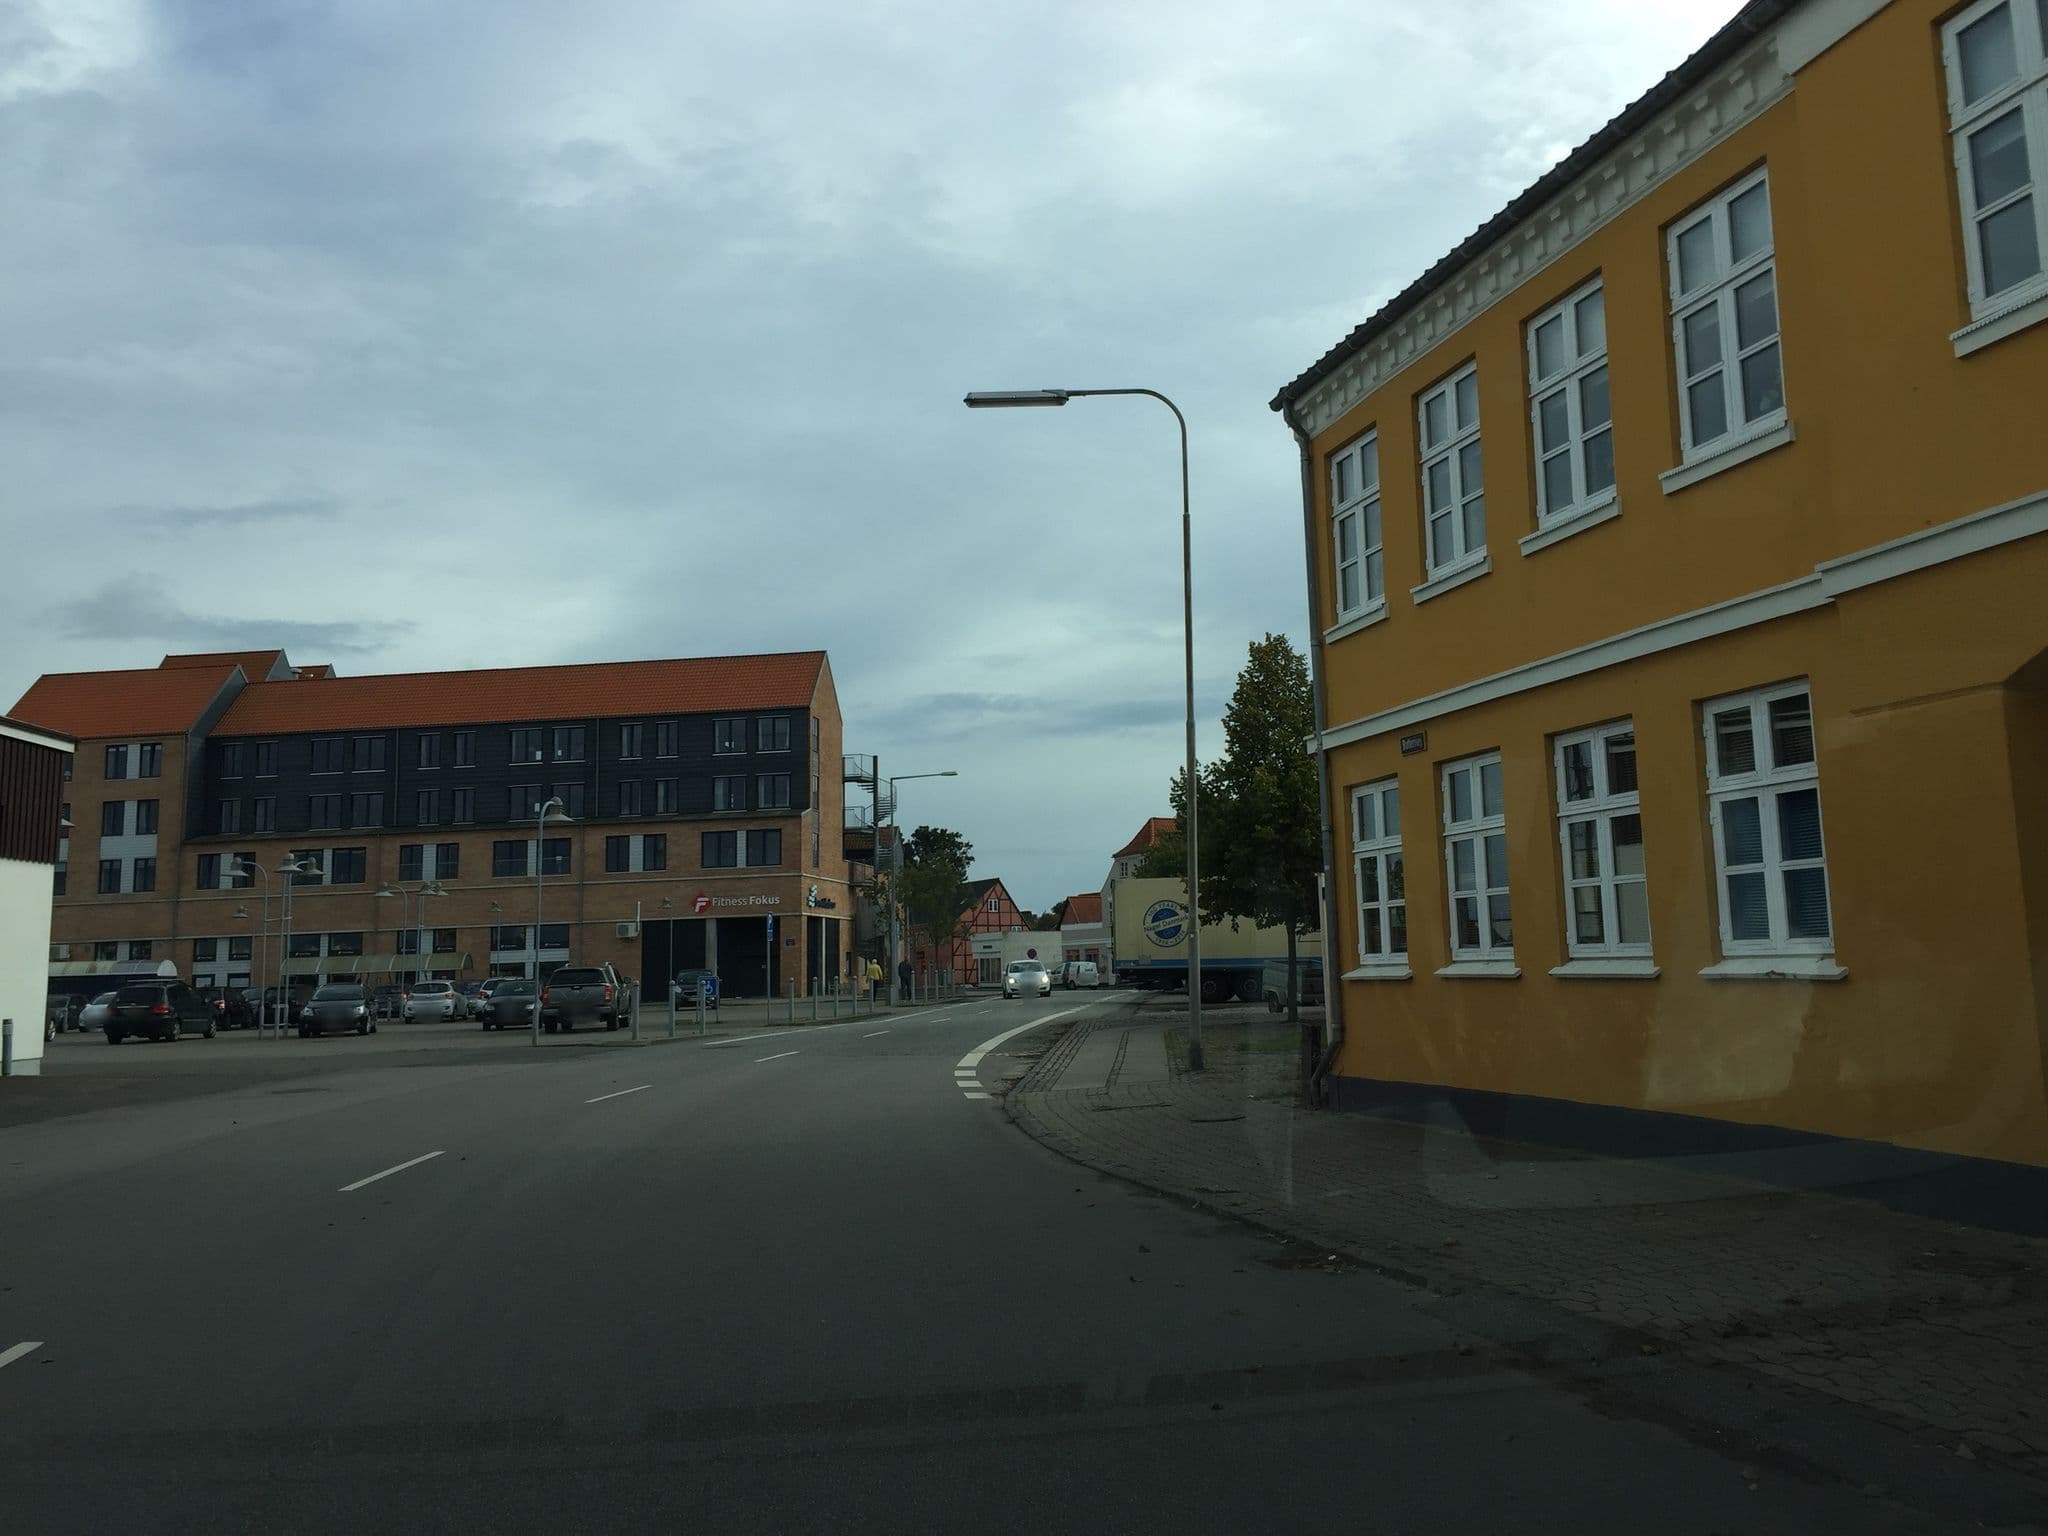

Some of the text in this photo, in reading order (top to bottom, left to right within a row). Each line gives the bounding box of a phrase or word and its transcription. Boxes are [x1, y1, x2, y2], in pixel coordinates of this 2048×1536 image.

[712, 895, 780, 907] Fitness Fokus
[1158, 902, 1178, 910] YEARS
